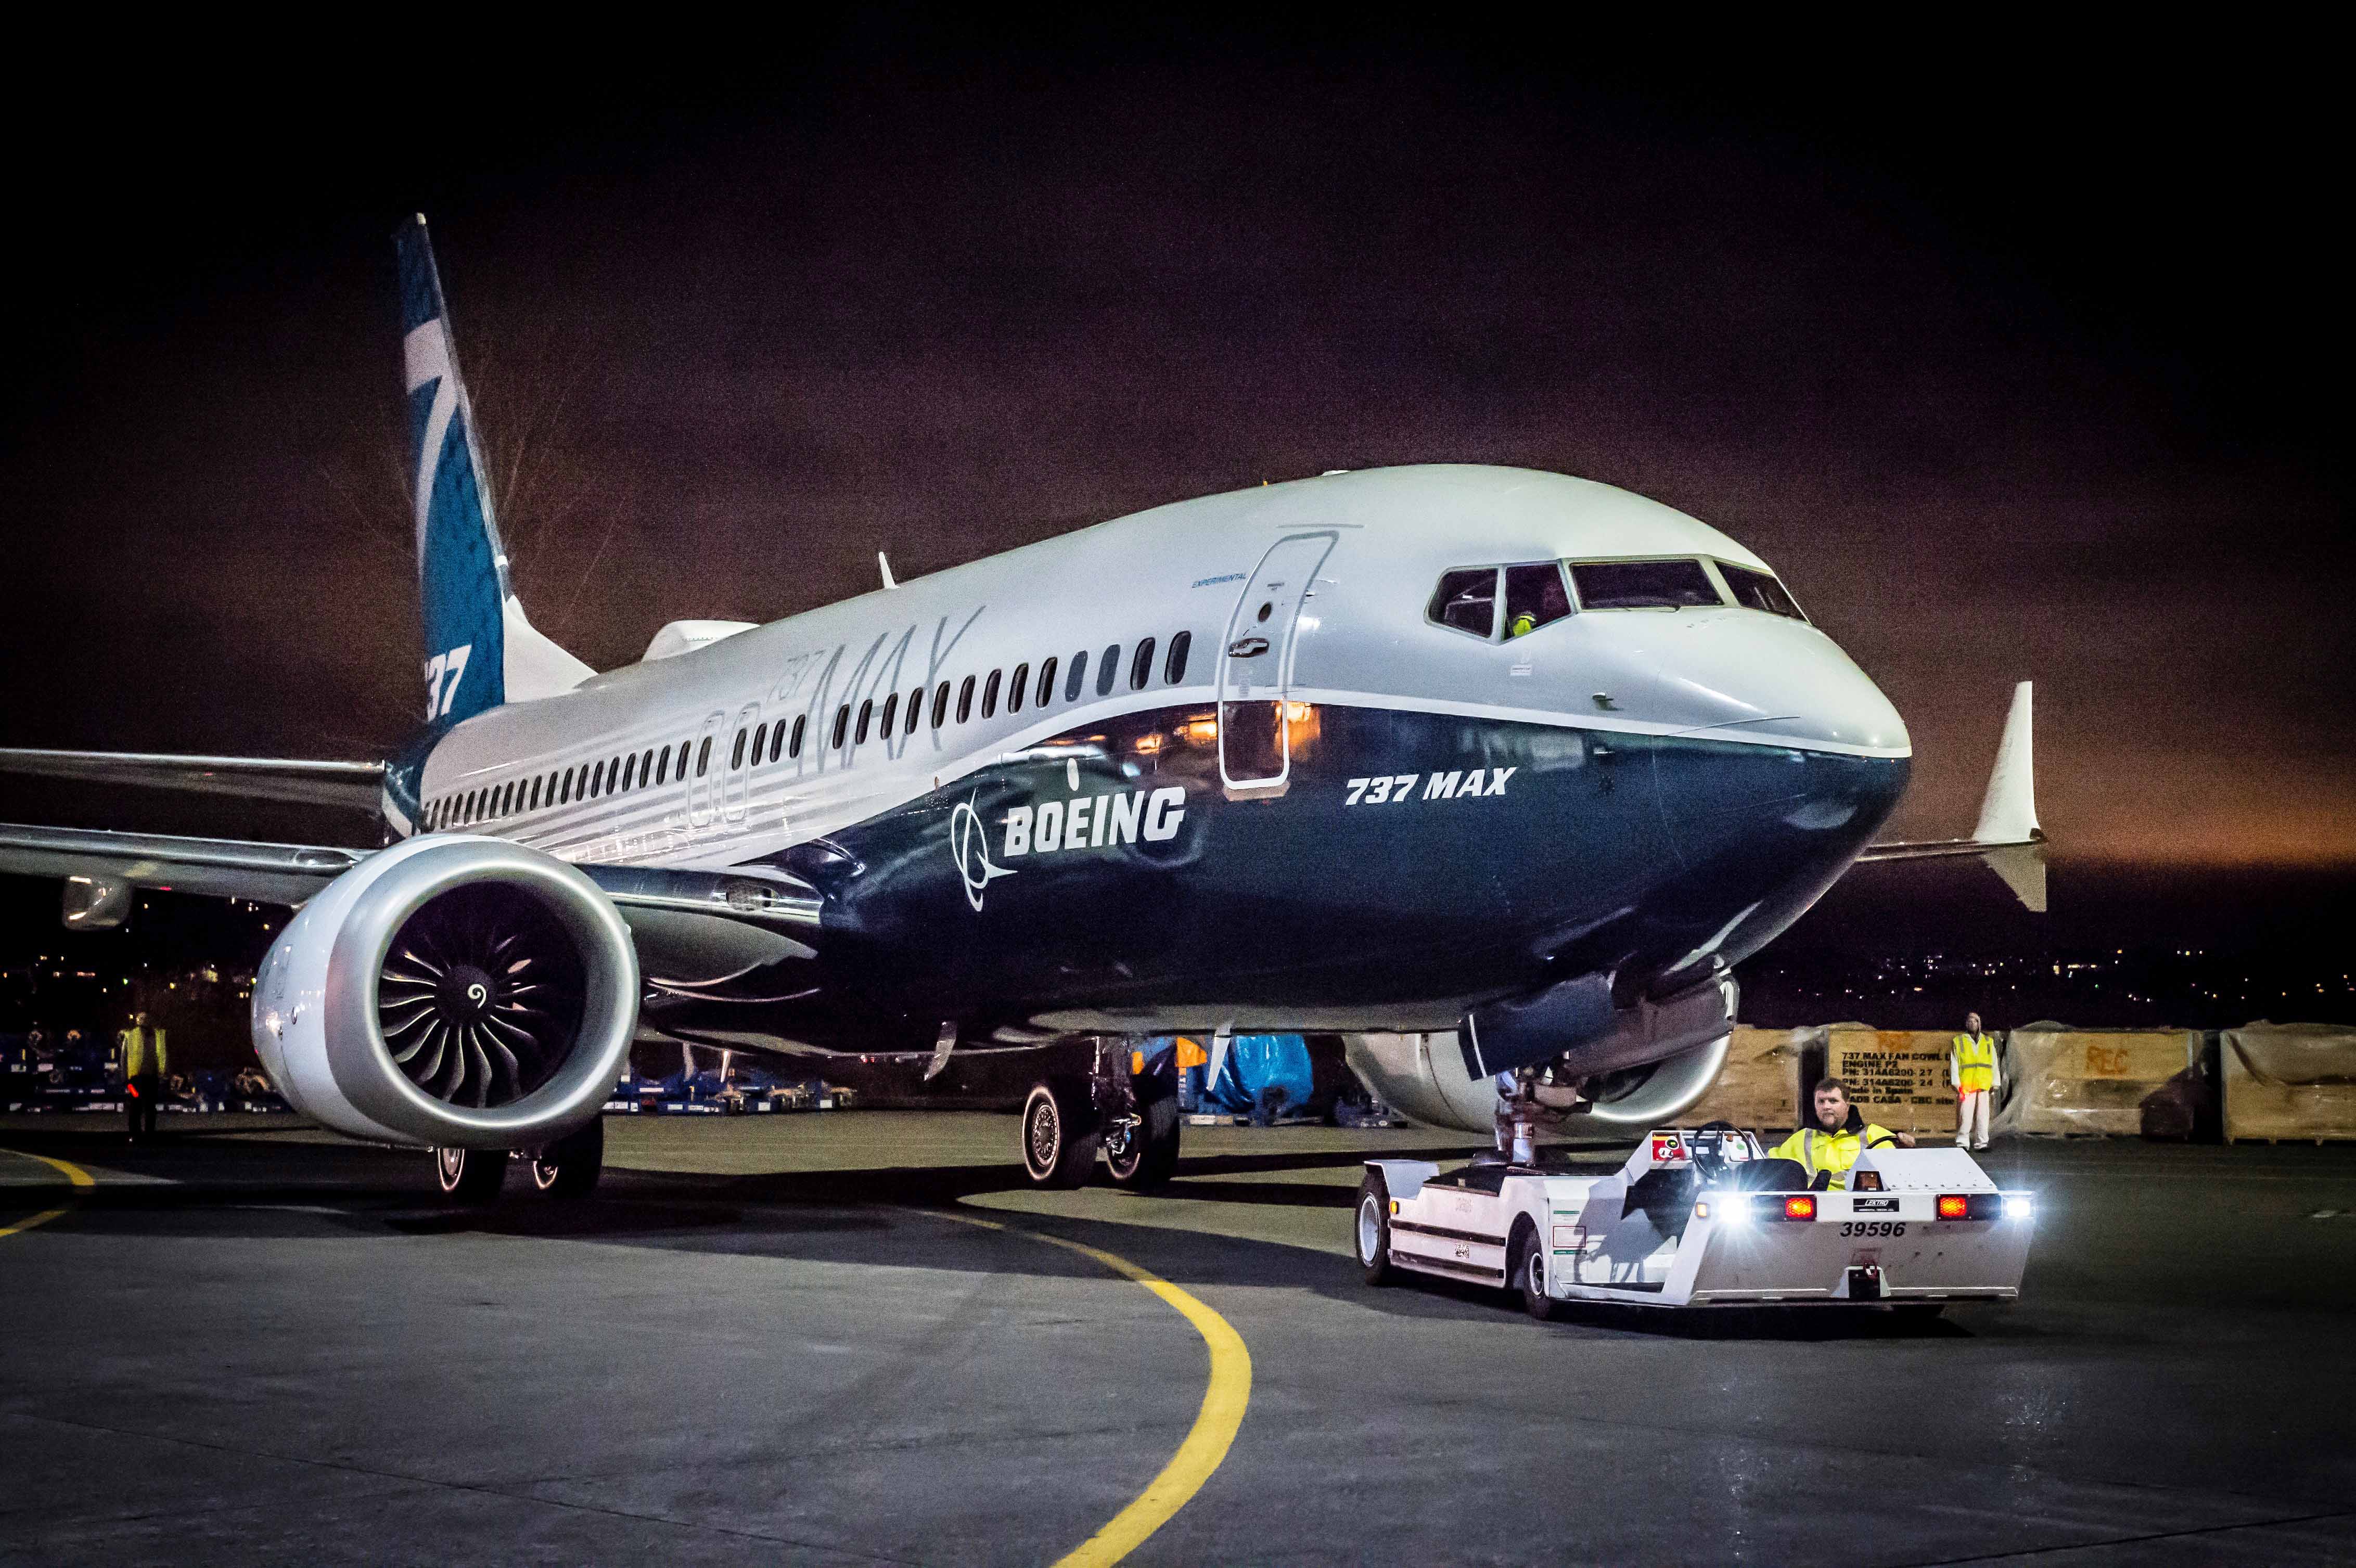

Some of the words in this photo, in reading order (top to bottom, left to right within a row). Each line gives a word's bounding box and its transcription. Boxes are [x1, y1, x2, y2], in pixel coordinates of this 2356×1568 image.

[1192, 573, 1246, 588] EXPERIMENTAL
[424, 644, 472, 722] 37
[1345, 774, 1419, 806] 737
[1422, 766, 1518, 800] MAX
[1004, 786, 1186, 857] BOEING
[2085, 1045, 2128, 1075] REC
[1840, 1222, 1906, 1237] 39596
